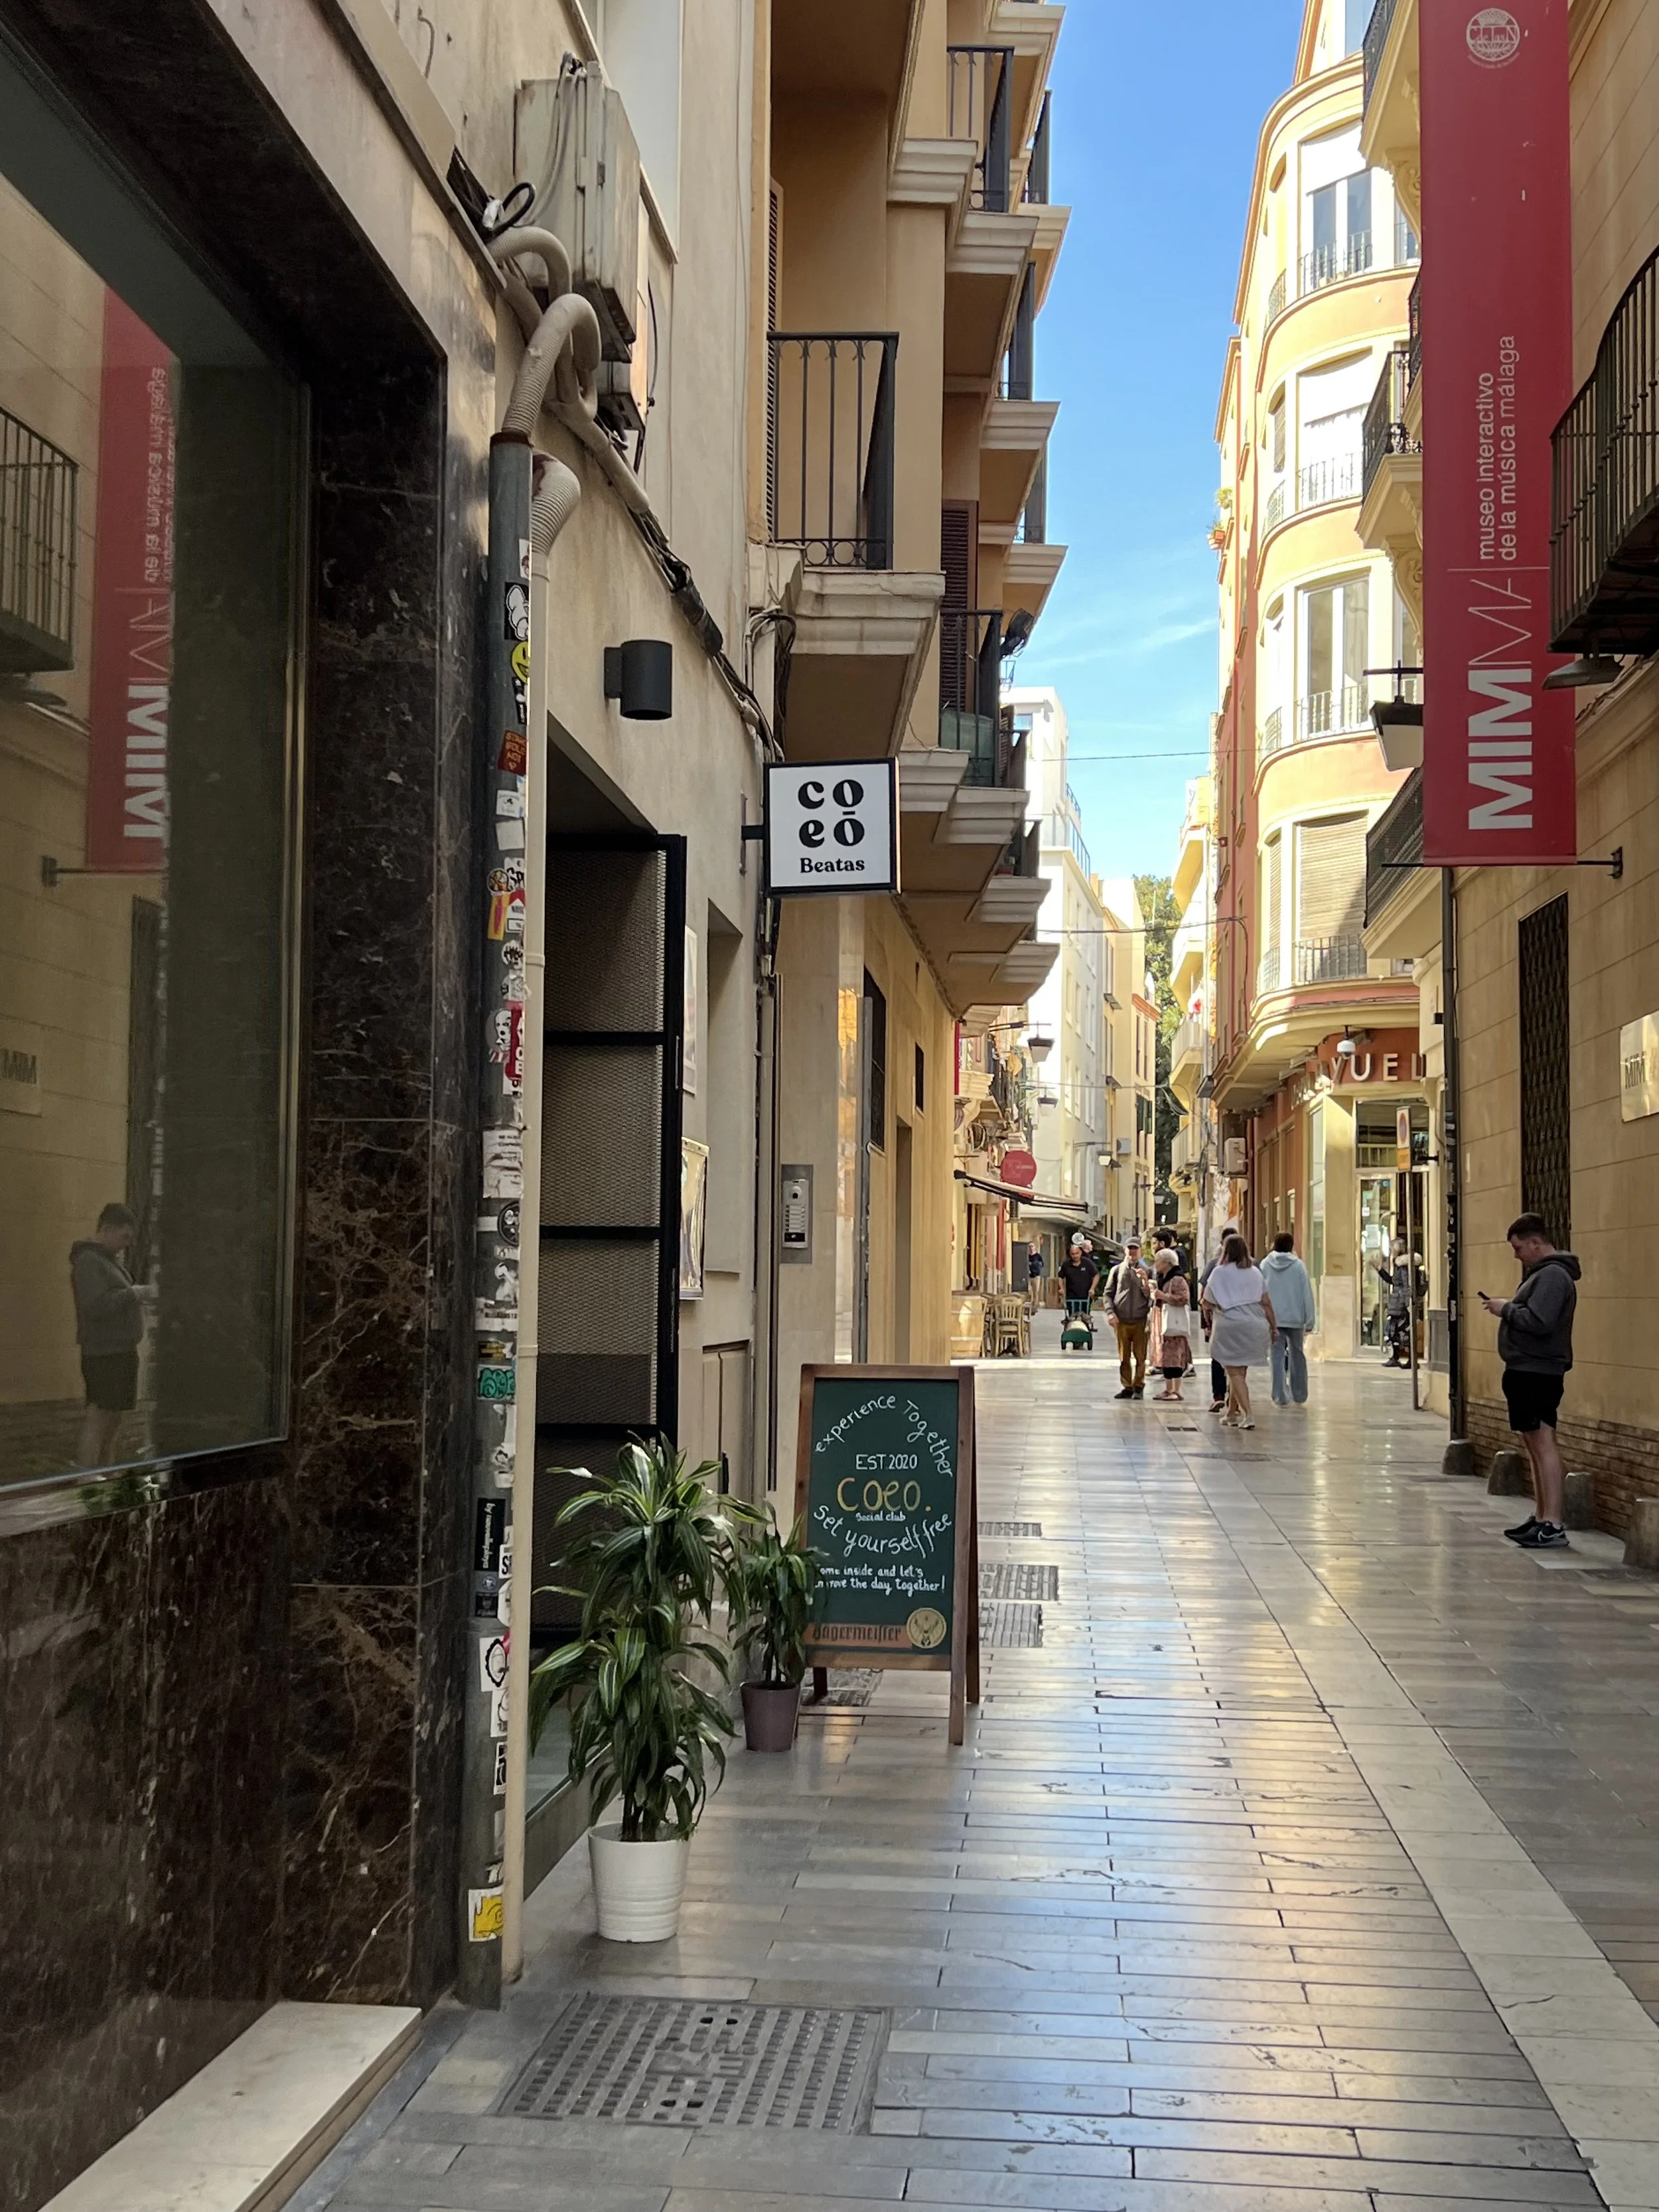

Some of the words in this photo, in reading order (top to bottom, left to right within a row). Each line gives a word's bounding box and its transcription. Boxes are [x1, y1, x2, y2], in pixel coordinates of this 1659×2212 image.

[1498, 336, 1520, 417] málaga
[1476, 372, 1494, 482] interactivo
[1497, 424, 1516, 504] música
[1480, 488, 1494, 560] museo
[1498, 511, 1516, 530] la
[1498, 534, 1517, 561] de
[1468, 578, 1533, 830] MIMMA
[800, 857, 865, 873] Beatas
[815, 1395, 896, 1452] experience
[855, 1453, 886, 1470] EST
[888, 1453, 918, 1470] 2020
[843, 1524, 926, 1558] yourself
[922, 1513, 952, 1552] free
[816, 1564, 840, 1575] ome
[877, 1564, 896, 1576] and
[900, 1564, 924, 1578] let's
[850, 1577, 867, 1589] the
[871, 1576, 892, 1595] day
